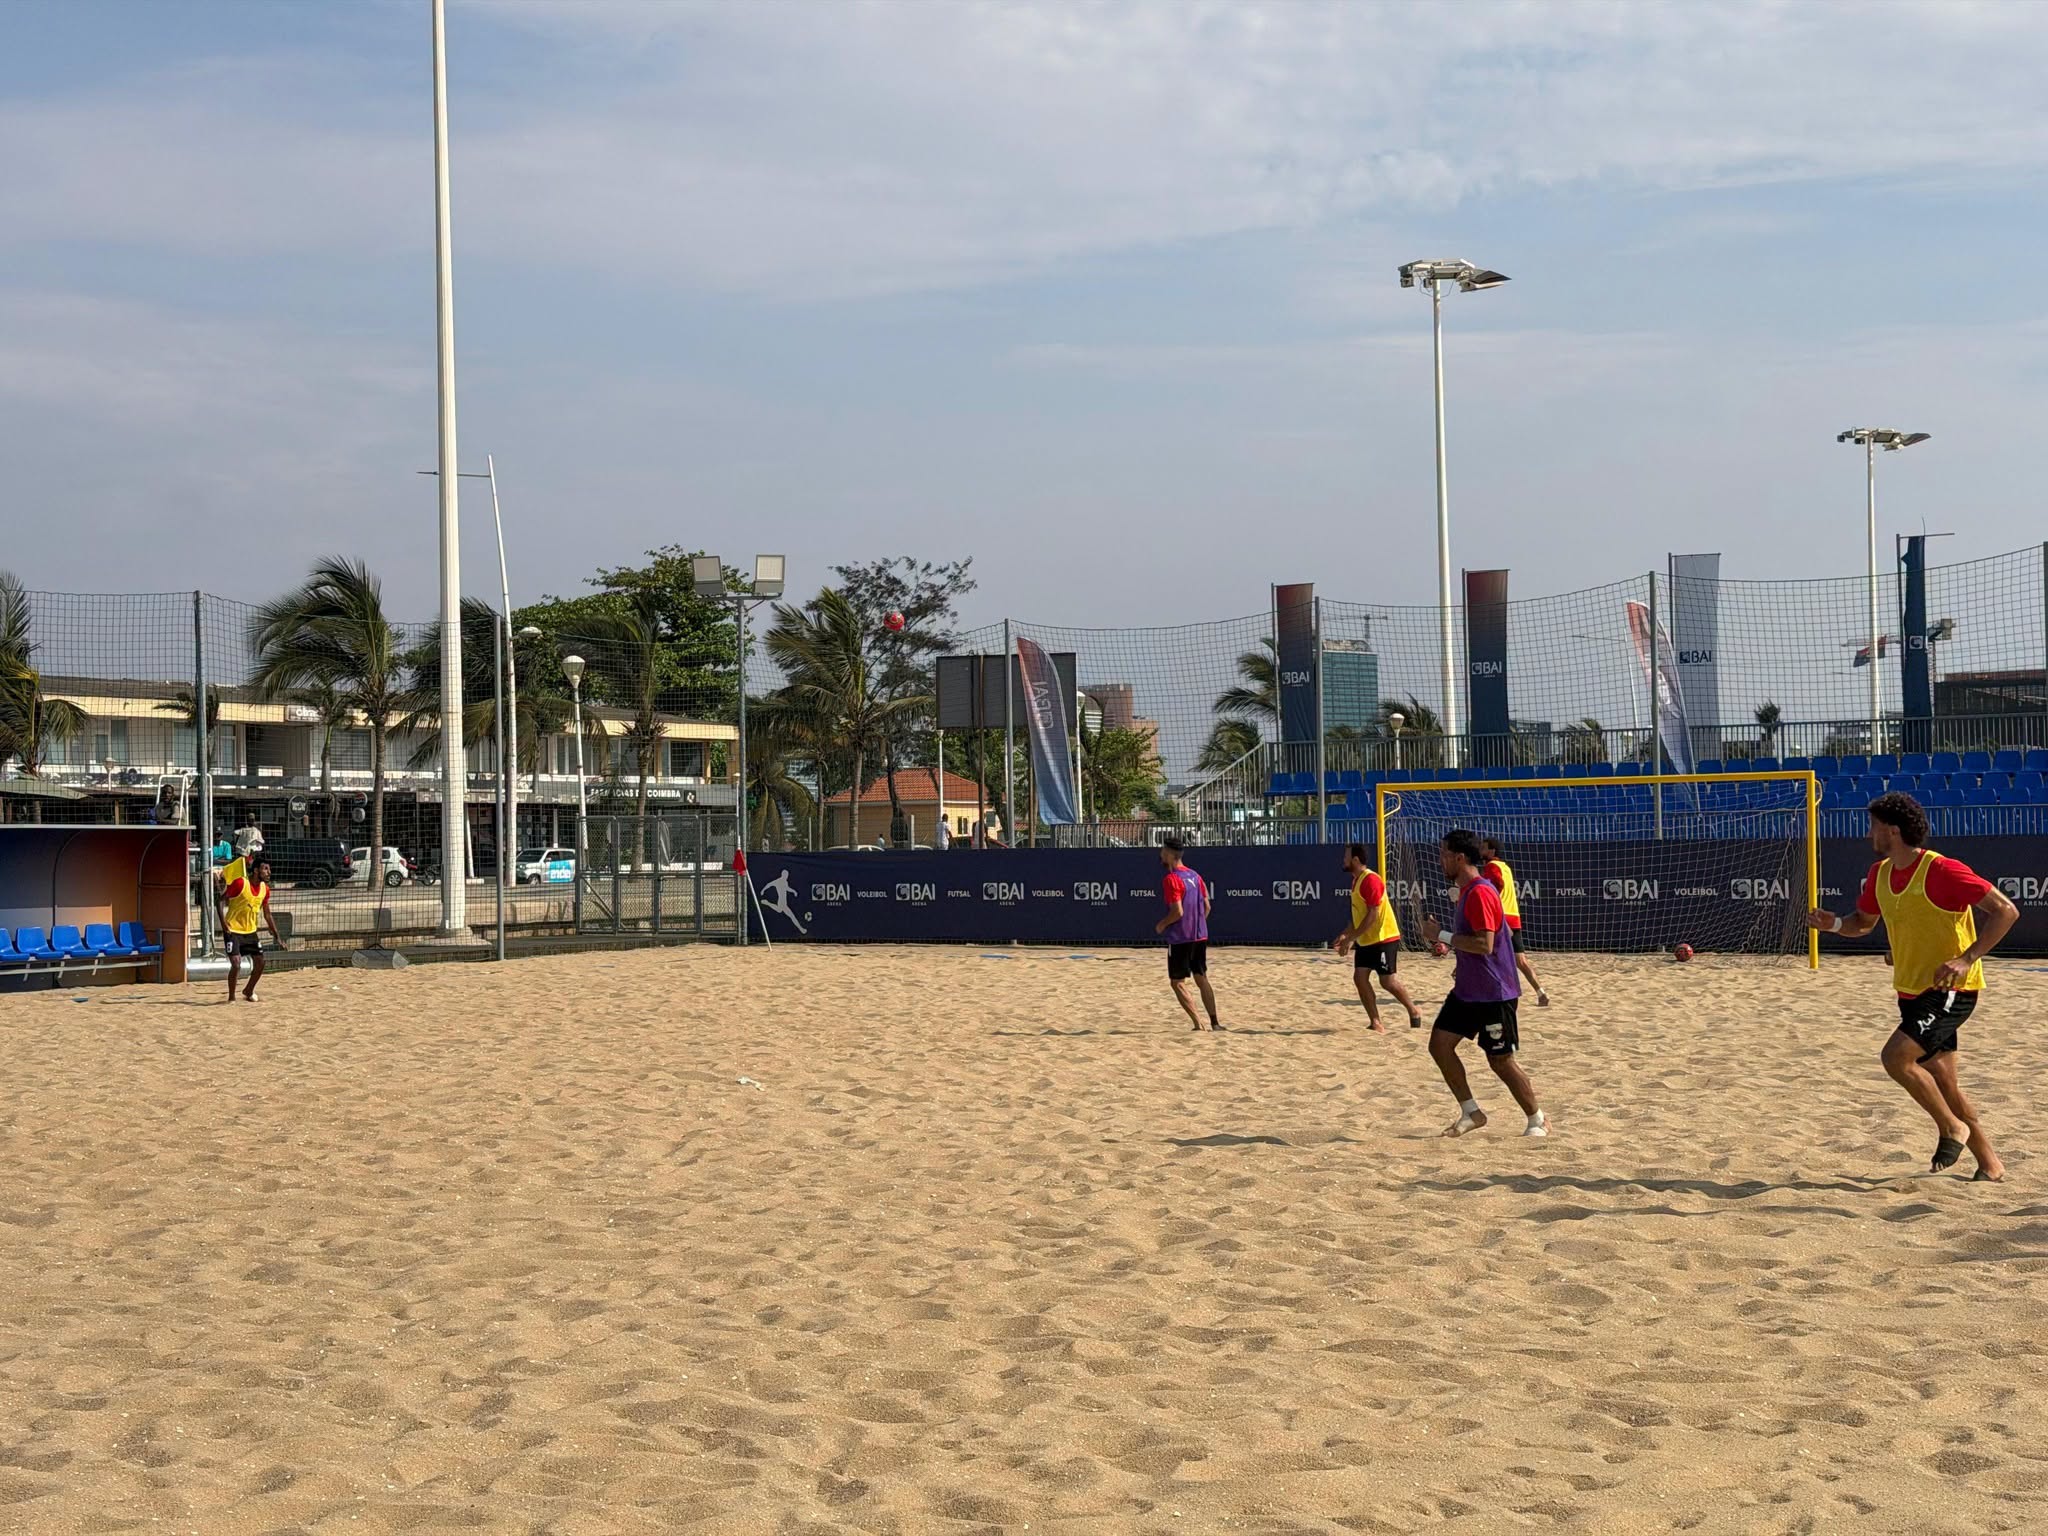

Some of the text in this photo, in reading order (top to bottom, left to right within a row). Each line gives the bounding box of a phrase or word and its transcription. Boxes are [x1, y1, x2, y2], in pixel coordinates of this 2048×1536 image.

[1691, 650, 1712, 663] BAI
[1482, 661, 1502, 674] BAI
[1291, 671, 1310, 683] BAI
[647, 789, 681, 798] COIMBRA
[827, 884, 850, 901] BAI
[912, 884, 935, 900] BAI
[948, 890, 971, 898] FUTSAL
[999, 882, 1024, 900] BAI
[1090, 882, 1117, 900] BAI
[1130, 889, 1156, 897] FUTSAL
[1226, 889, 1263, 897] VOLEIBOL
[1291, 880, 1320, 900] BAI
[1396, 880, 1427, 900] BAI
[1555, 888, 1587, 896] FUTSAL
[1624, 879, 1658, 900] BAI
[1674, 888, 1718, 896] VOLEIBOL
[1754, 879, 1789, 900] BAI
[2022, 877, 2048, 899] BA
